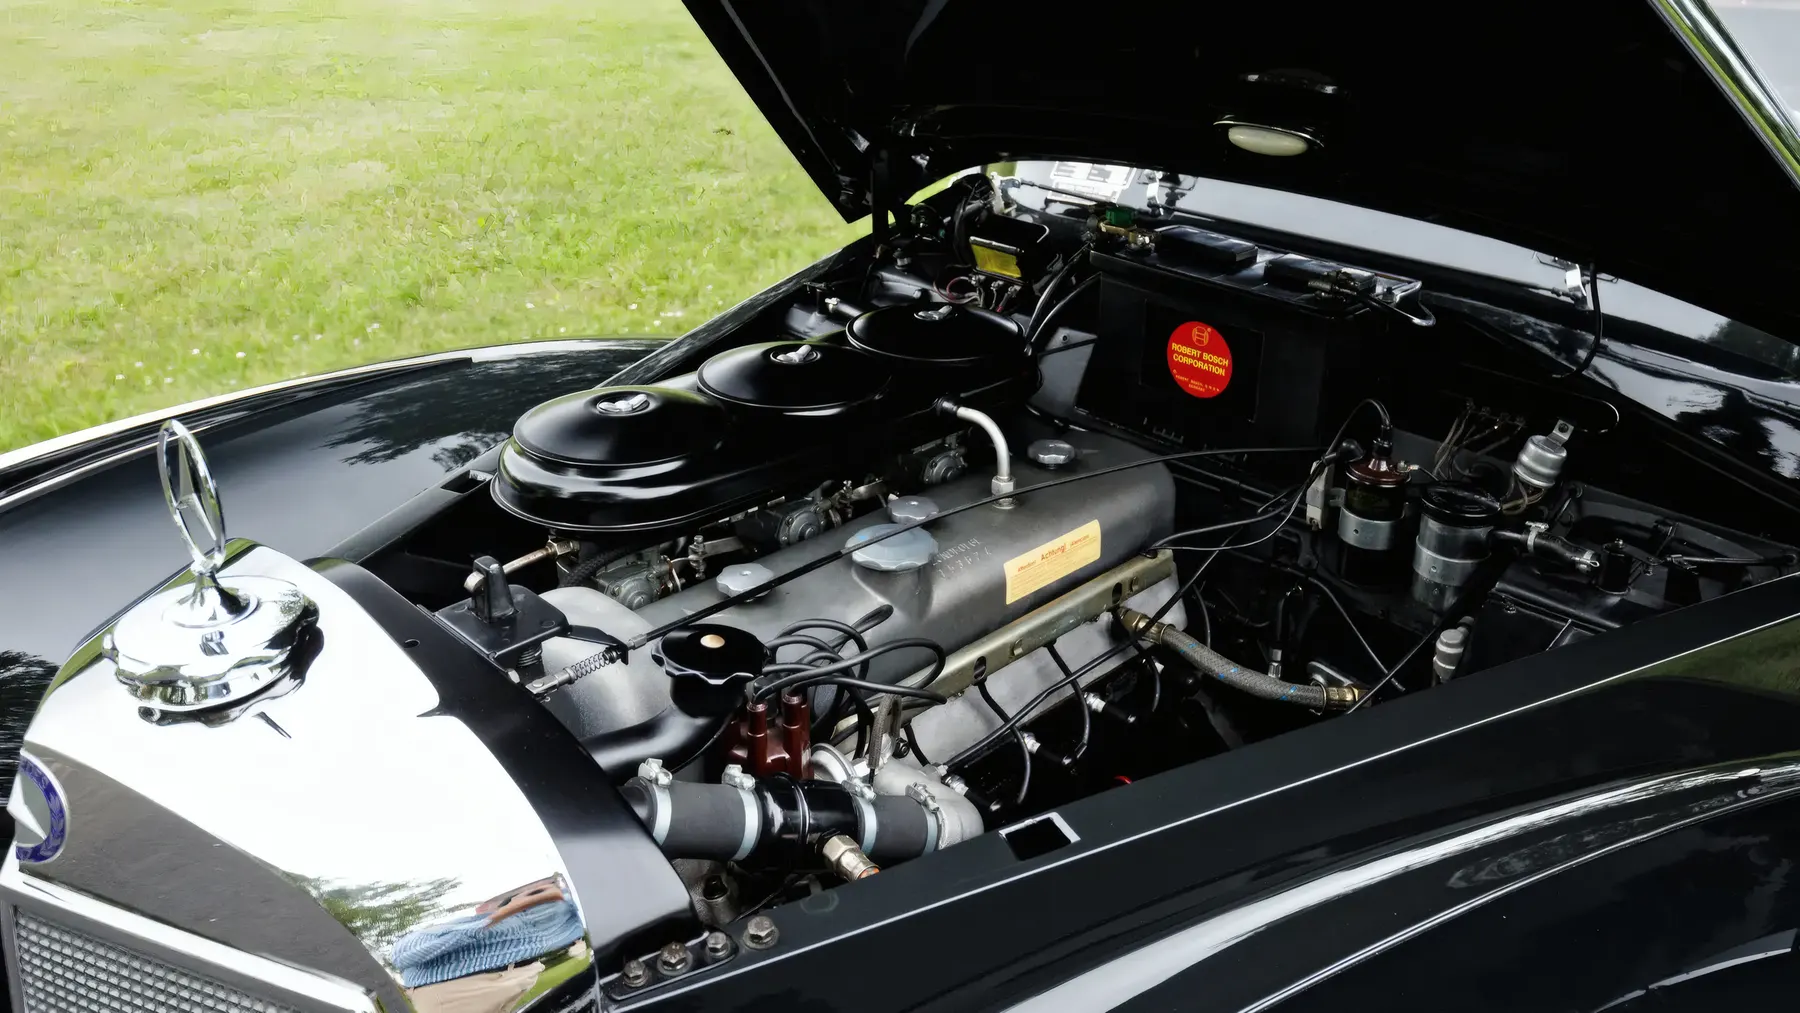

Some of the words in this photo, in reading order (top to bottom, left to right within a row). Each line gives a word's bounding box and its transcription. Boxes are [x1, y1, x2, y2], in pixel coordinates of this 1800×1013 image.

[1171, 342, 1201, 358] ROBERT
[1202, 352, 1229, 367] BOSCH
[1172, 353, 1226, 376] CORPORATION
[1040, 543, 1067, 561] Achtung!
